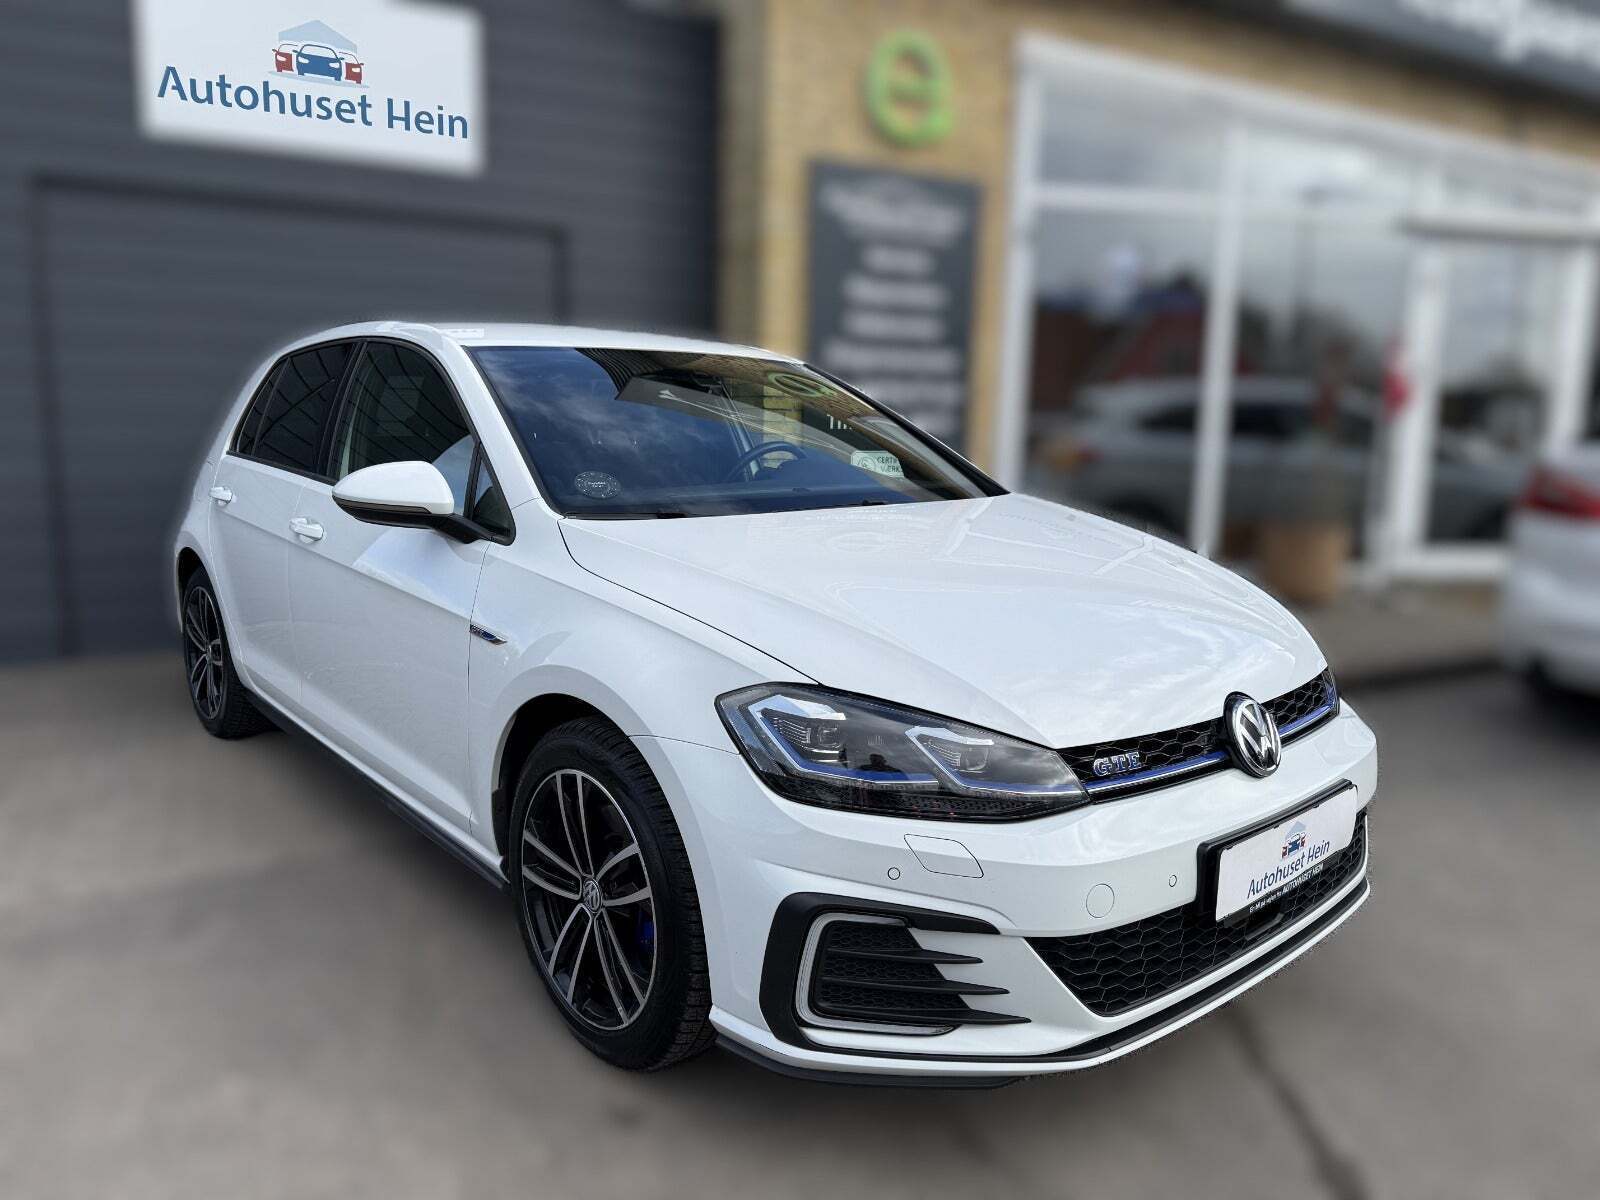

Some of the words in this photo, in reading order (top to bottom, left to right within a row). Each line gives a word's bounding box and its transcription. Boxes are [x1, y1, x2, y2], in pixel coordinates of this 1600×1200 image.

[157, 65, 373, 127] Autohuset
[386, 97, 468, 139] Hein
[1093, 752, 1142, 776] GTE
[1247, 852, 1306, 899] Autohuset
[1307, 840, 1330, 865] Hein
